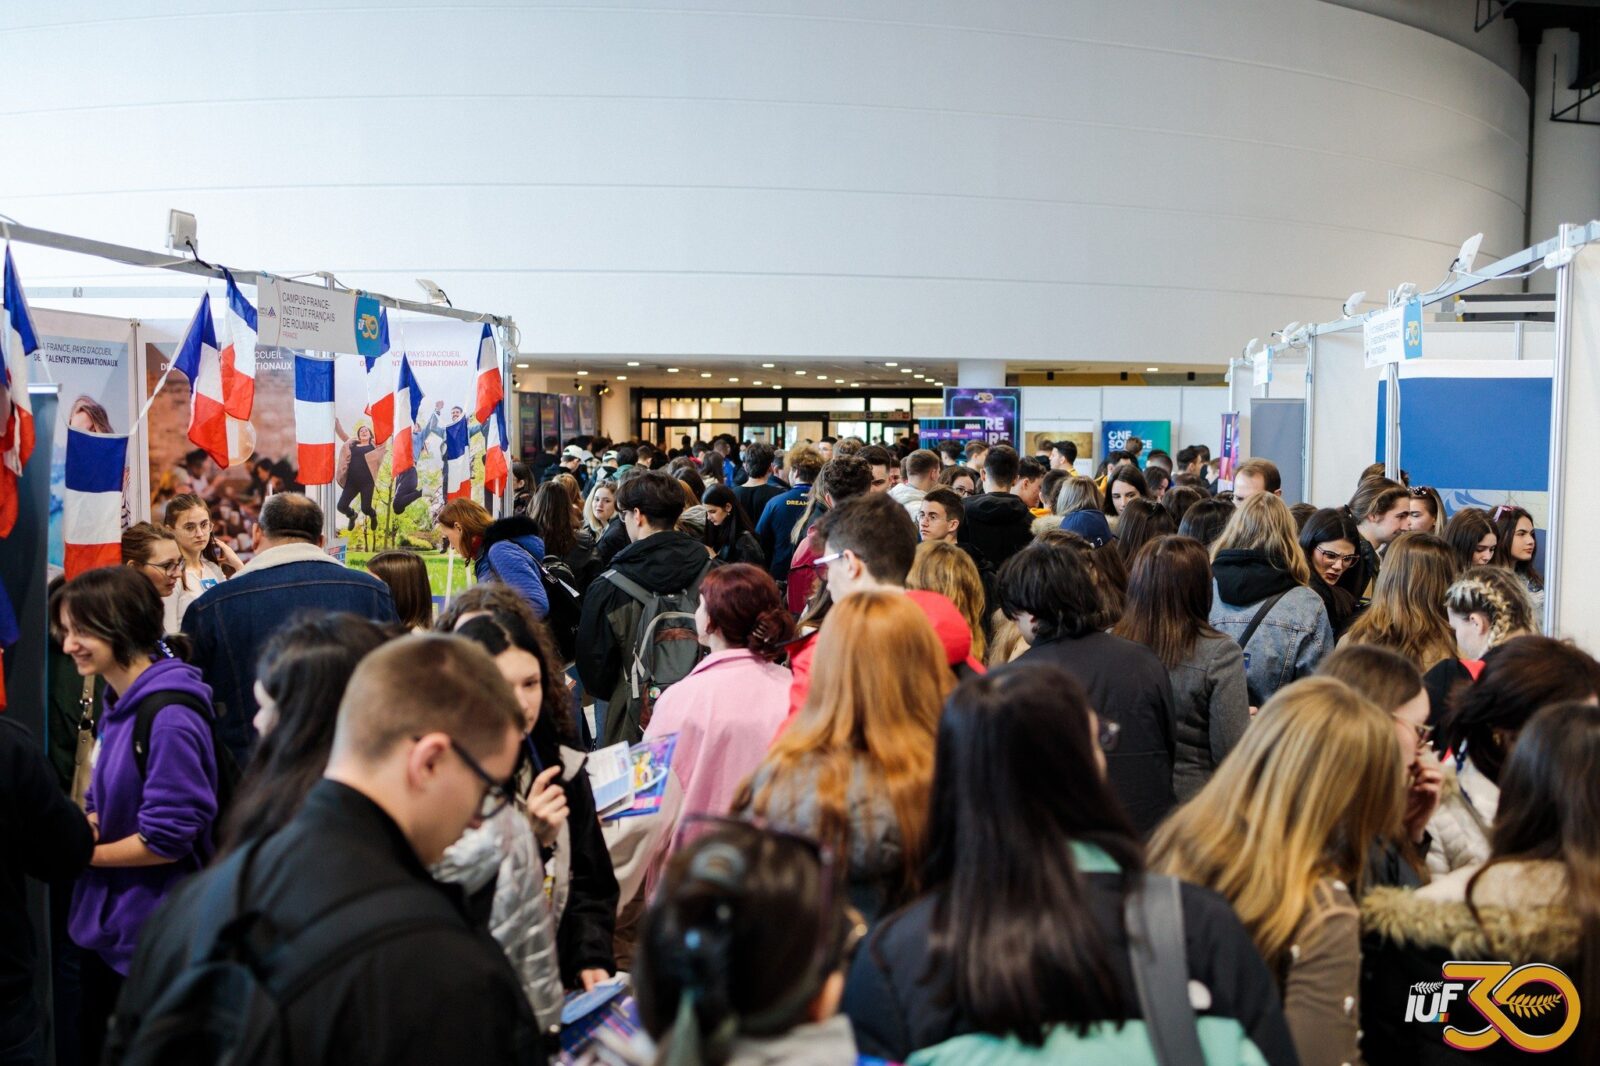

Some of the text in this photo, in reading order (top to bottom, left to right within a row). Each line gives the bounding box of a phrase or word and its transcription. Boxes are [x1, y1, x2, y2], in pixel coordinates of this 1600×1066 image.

[282, 292, 331, 309] CAMPUS FRANCE-
[282, 305, 307, 317] INSTITUT
[308, 309, 335, 323] FRANÇAIS
[282, 317, 320, 332] DE ROUMANIE
[47, 342, 71, 353] FRANCE,
[72, 345, 85, 354] PAYS
[87, 346, 113, 356] D'ACCUEIL
[71, 356, 119, 367] INTERNATIONAUX
[1108, 440, 1153, 449] SOCE
